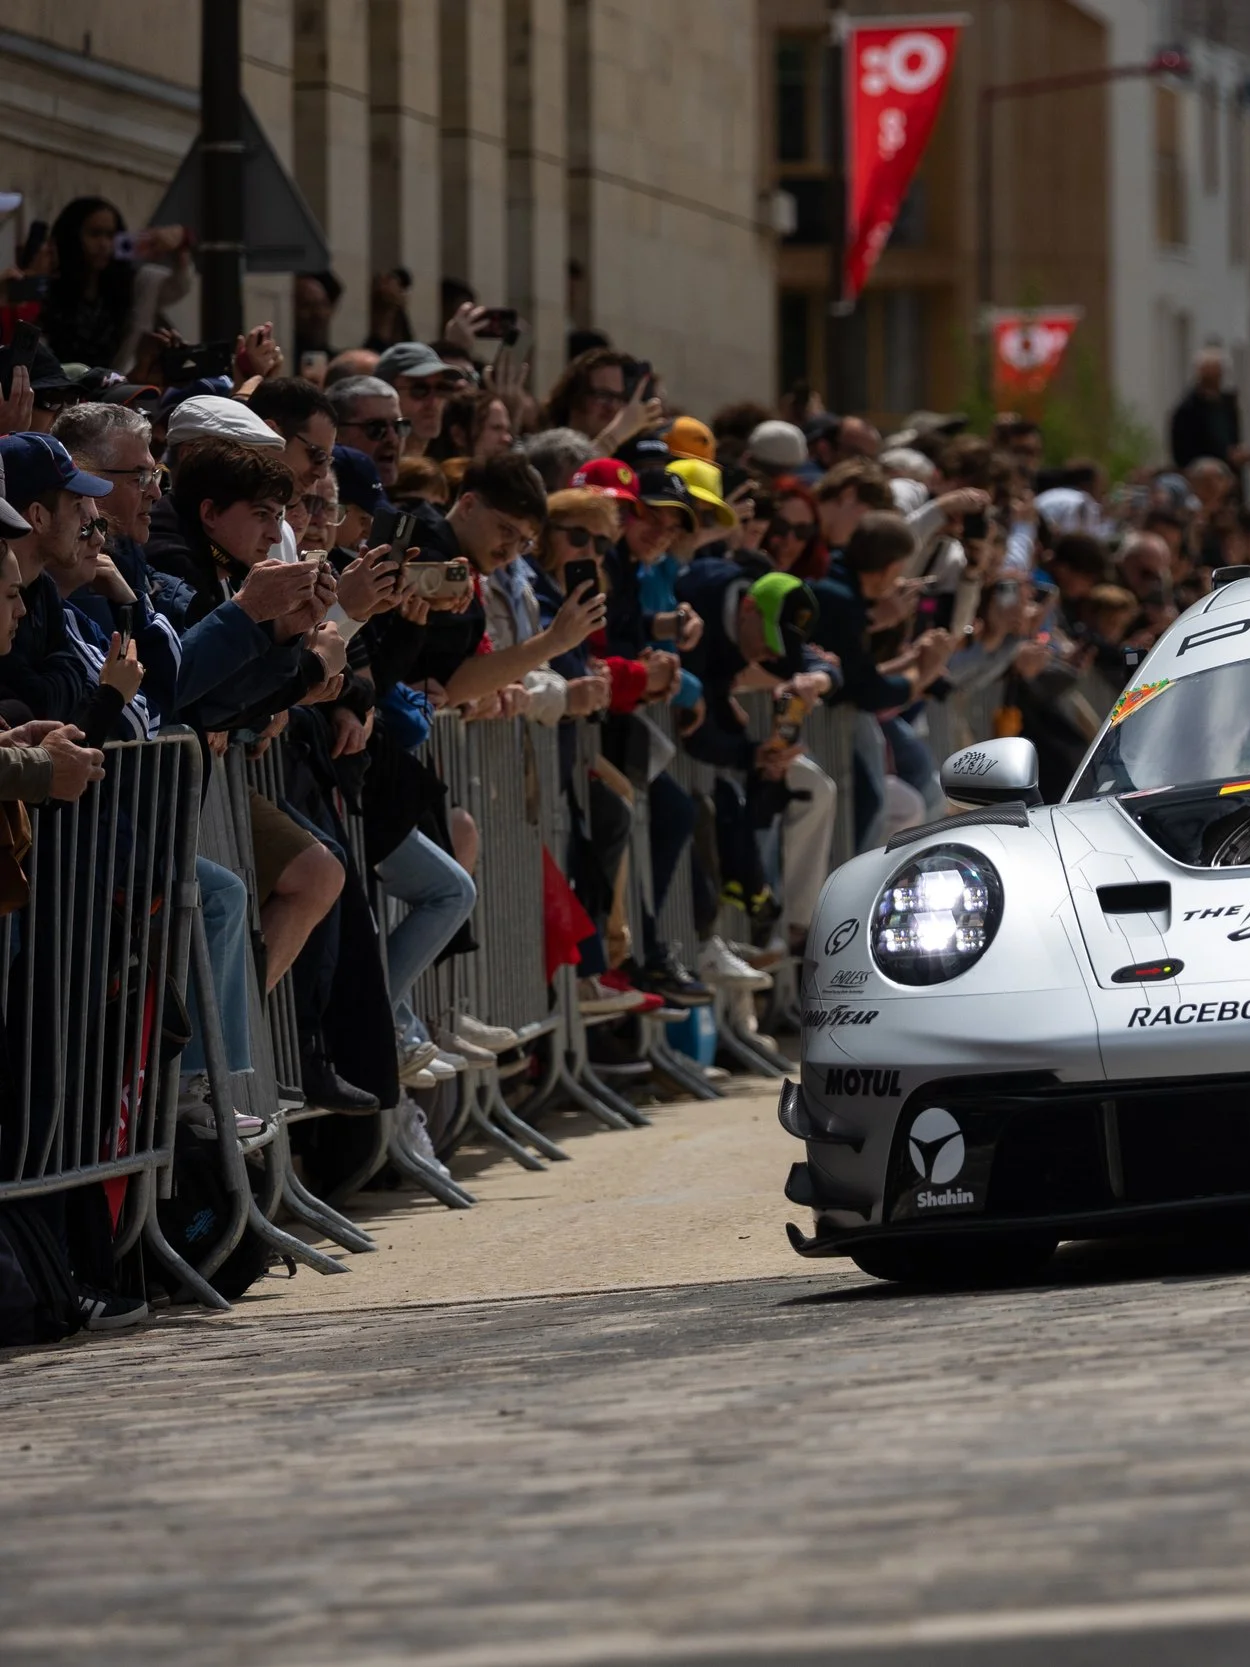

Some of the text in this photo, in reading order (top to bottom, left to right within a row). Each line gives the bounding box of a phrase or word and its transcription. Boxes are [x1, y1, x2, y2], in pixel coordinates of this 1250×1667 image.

[1183, 904, 1245, 922] THE
[830, 970, 874, 985] ENDLESS
[825, 1069, 902, 1097] MOTUL
[917, 1188, 974, 1208] Shahin
